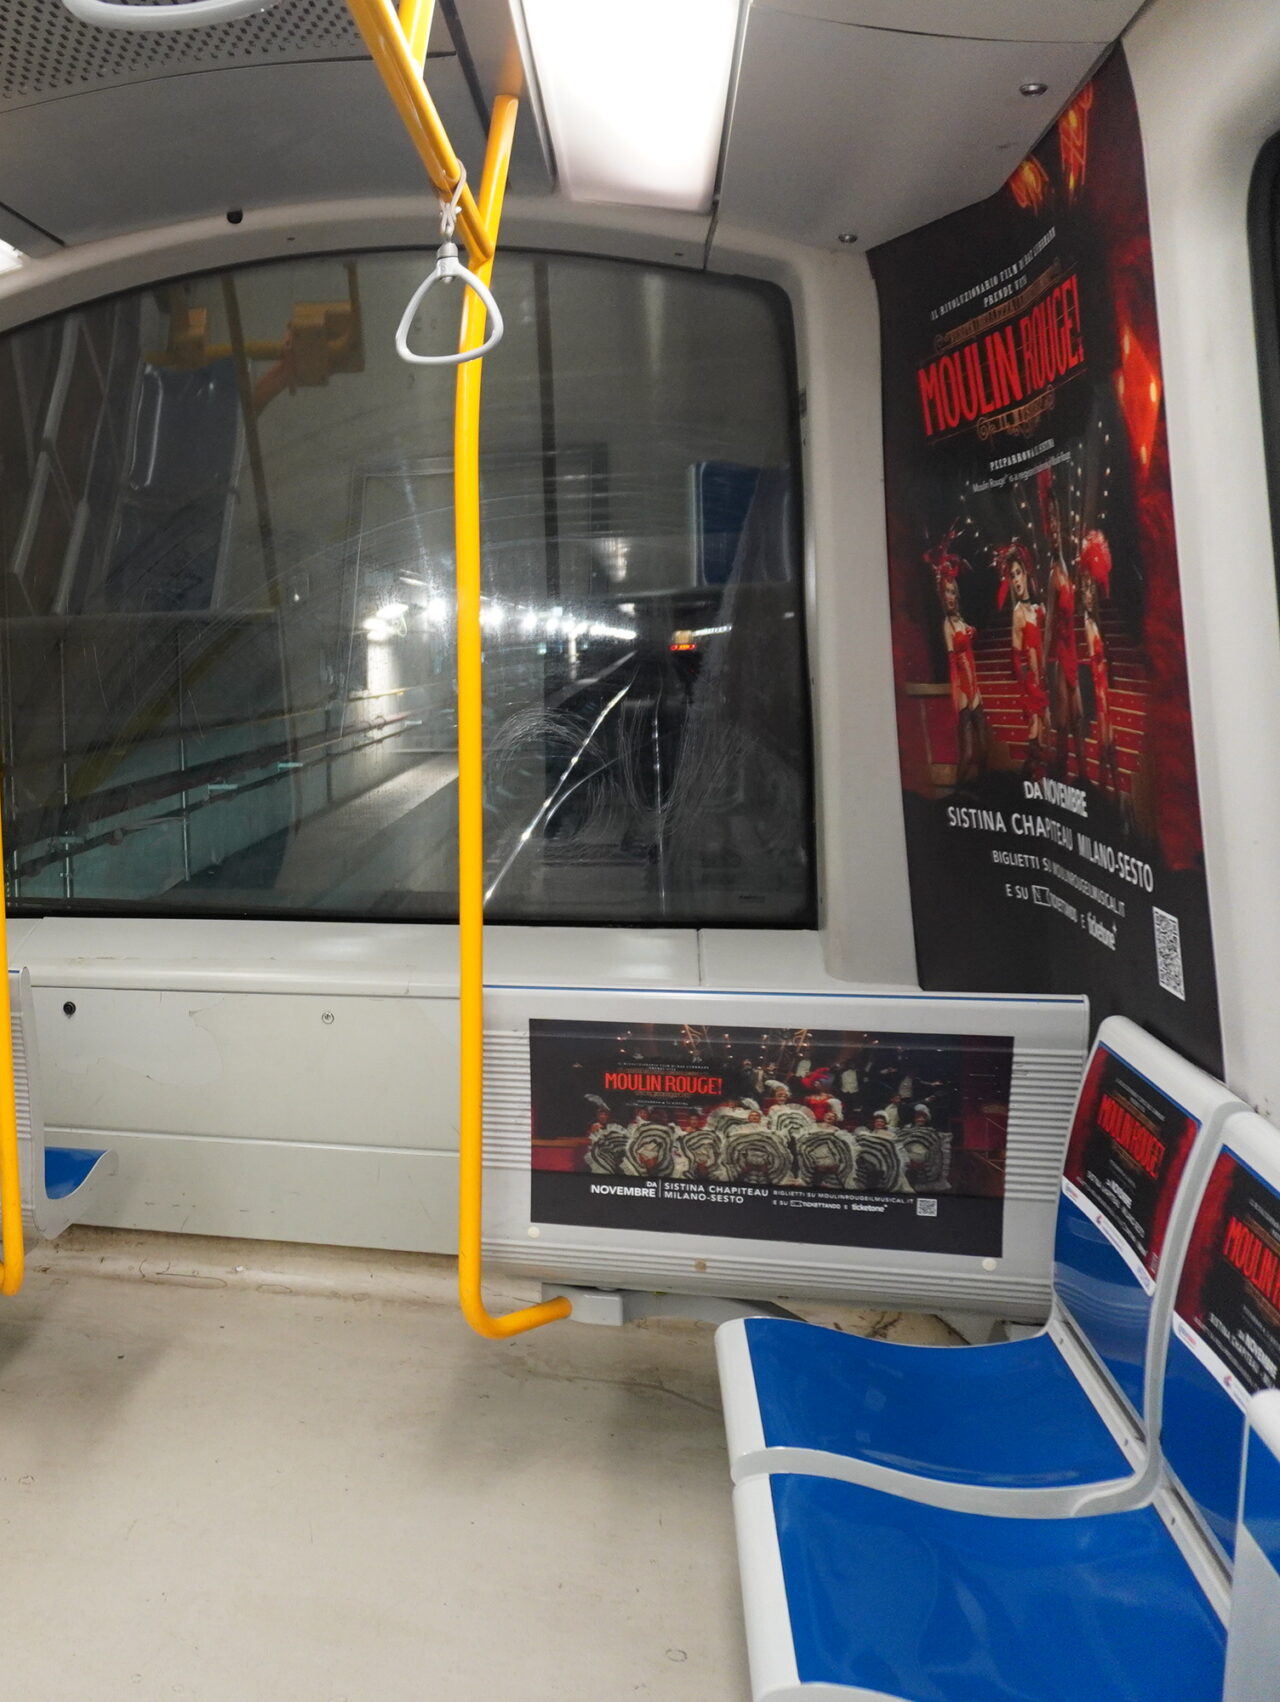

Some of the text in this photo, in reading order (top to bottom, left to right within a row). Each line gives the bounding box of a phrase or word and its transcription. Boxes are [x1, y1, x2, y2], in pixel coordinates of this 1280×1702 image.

[917, 273, 1084, 436] MOULIN ROUGE!
[1023, 776, 1088, 818] DA NOVEMBRE
[947, 806, 1154, 893] SISTINA CHAPITEAU MILANO-SESTO
[992, 850, 1040, 869] BIGLIETTI
[1005, 884, 1013, 897] E
[1015, 885, 1028, 900] SU
[605, 1072, 723, 1095] MOULIN ROUGE!
[590, 1184, 656, 1198] NOVEMBRE
[664, 1182, 769, 1197] SISTINA CHAPITEAU
[664, 1191, 744, 1204] MILANO-SESTO
